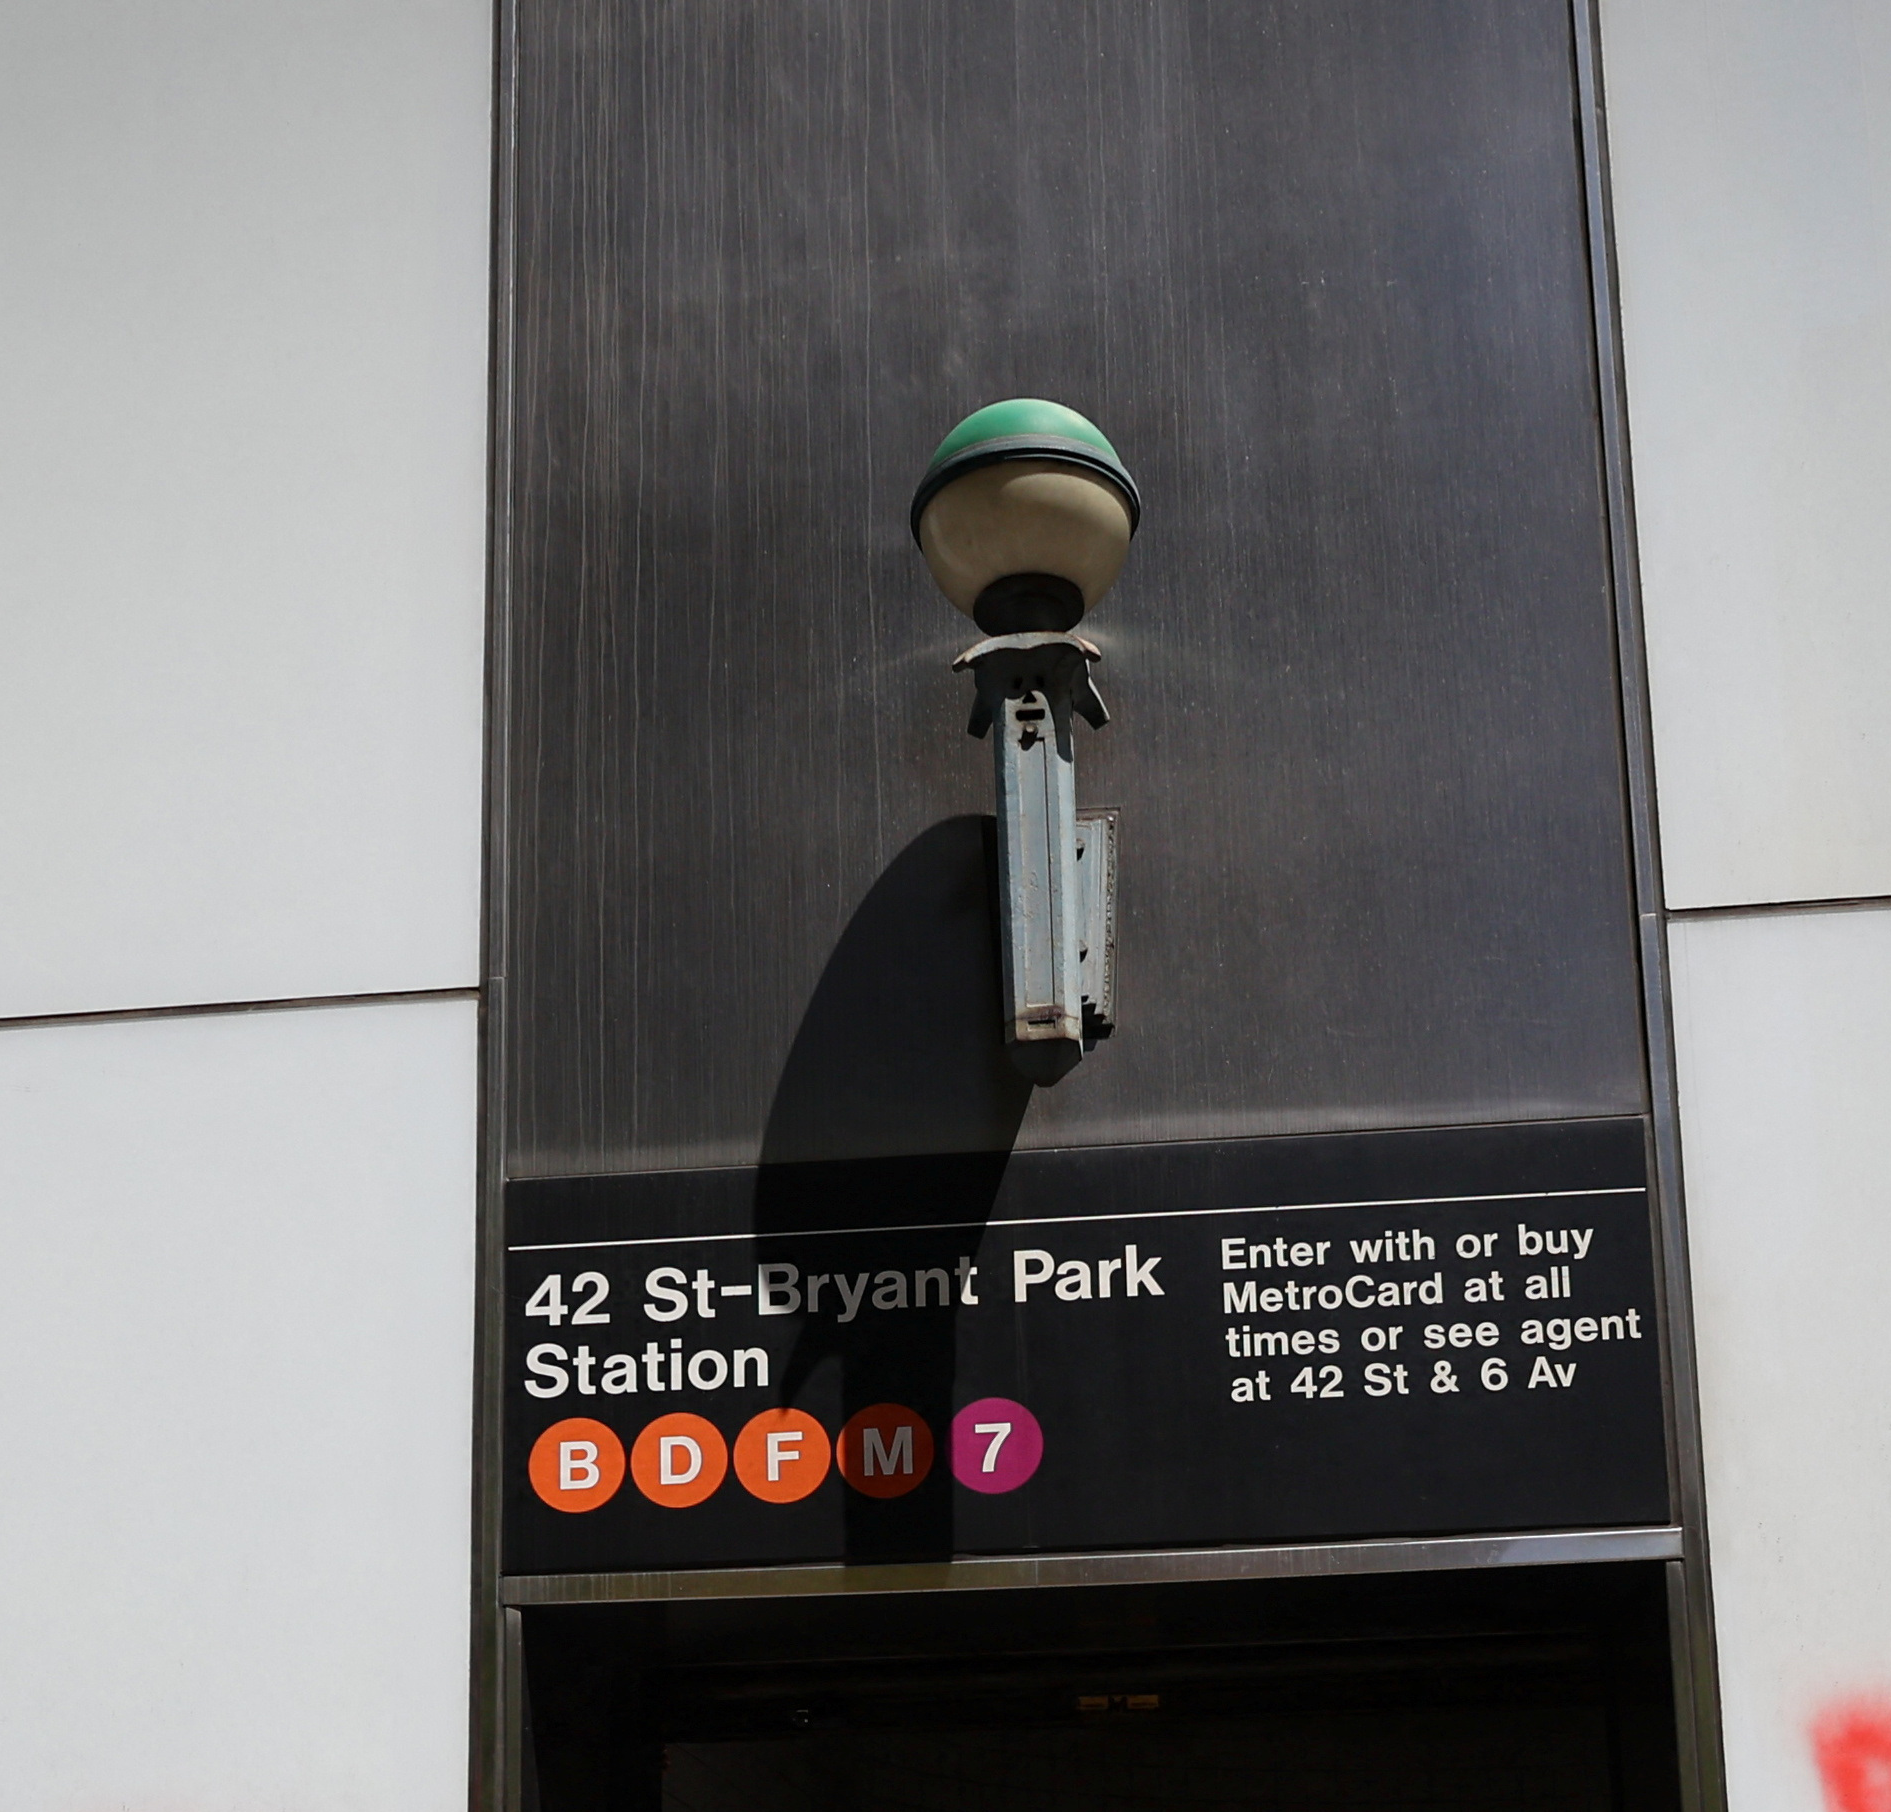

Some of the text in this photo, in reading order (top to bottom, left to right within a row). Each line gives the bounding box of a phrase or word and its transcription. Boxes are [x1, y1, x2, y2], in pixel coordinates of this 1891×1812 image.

[1221, 1224, 1594, 1270] Enter with or buy
[525, 1273, 610, 1326] 42
[1013, 1244, 1165, 1303] Park
[1222, 1266, 1571, 1314] MetroCard at all
[1225, 1308, 1642, 1358] times or see agent
[524, 1337, 769, 1398] Station
[1230, 1356, 1577, 1403] at 42 St & 6 Av
[559, 1422, 1011, 1490] B D F M 7
